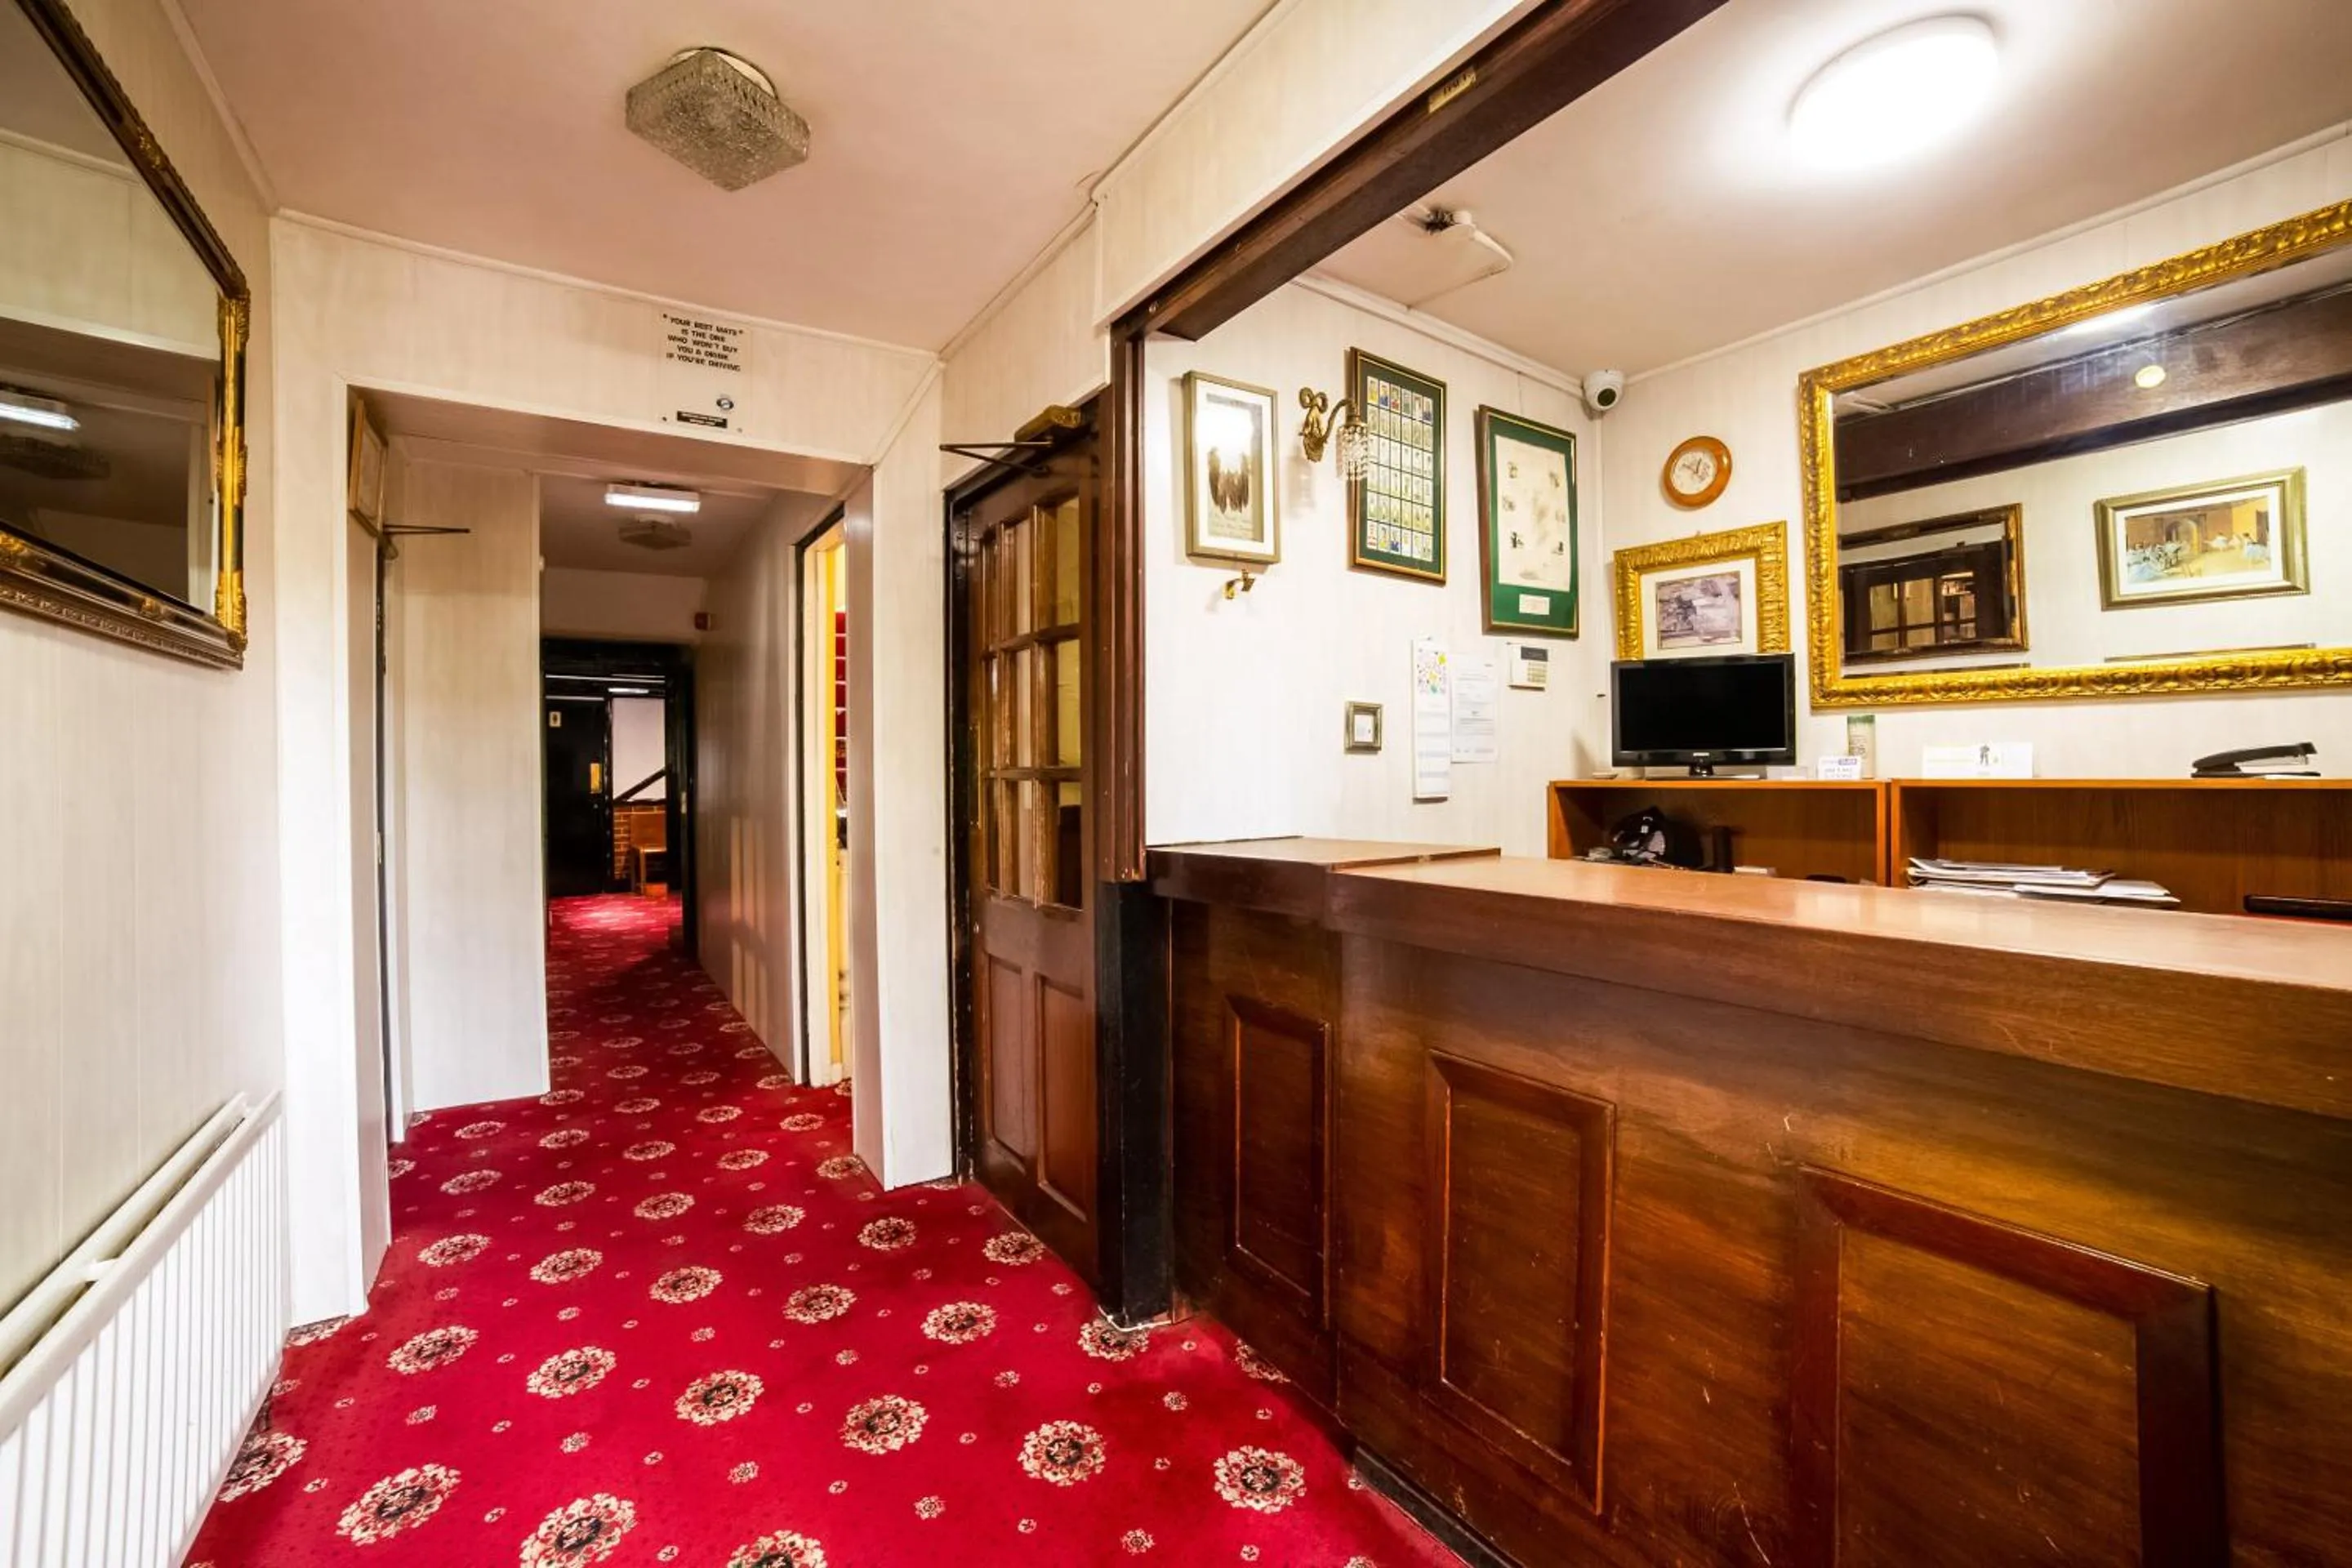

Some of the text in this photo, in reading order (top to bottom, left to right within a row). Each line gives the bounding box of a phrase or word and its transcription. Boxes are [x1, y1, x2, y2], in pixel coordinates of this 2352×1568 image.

[670, 317, 691, 327] YOUR
[694, 322, 712, 332] BEST
[692, 330, 706, 338] THE
[709, 333, 725, 342] ONE
[667, 334, 738, 353] WHO WON'T BUY
[677, 345, 693, 354] YOU
[704, 350, 728, 359] DRINK
[709, 359, 741, 372] DRIVING
